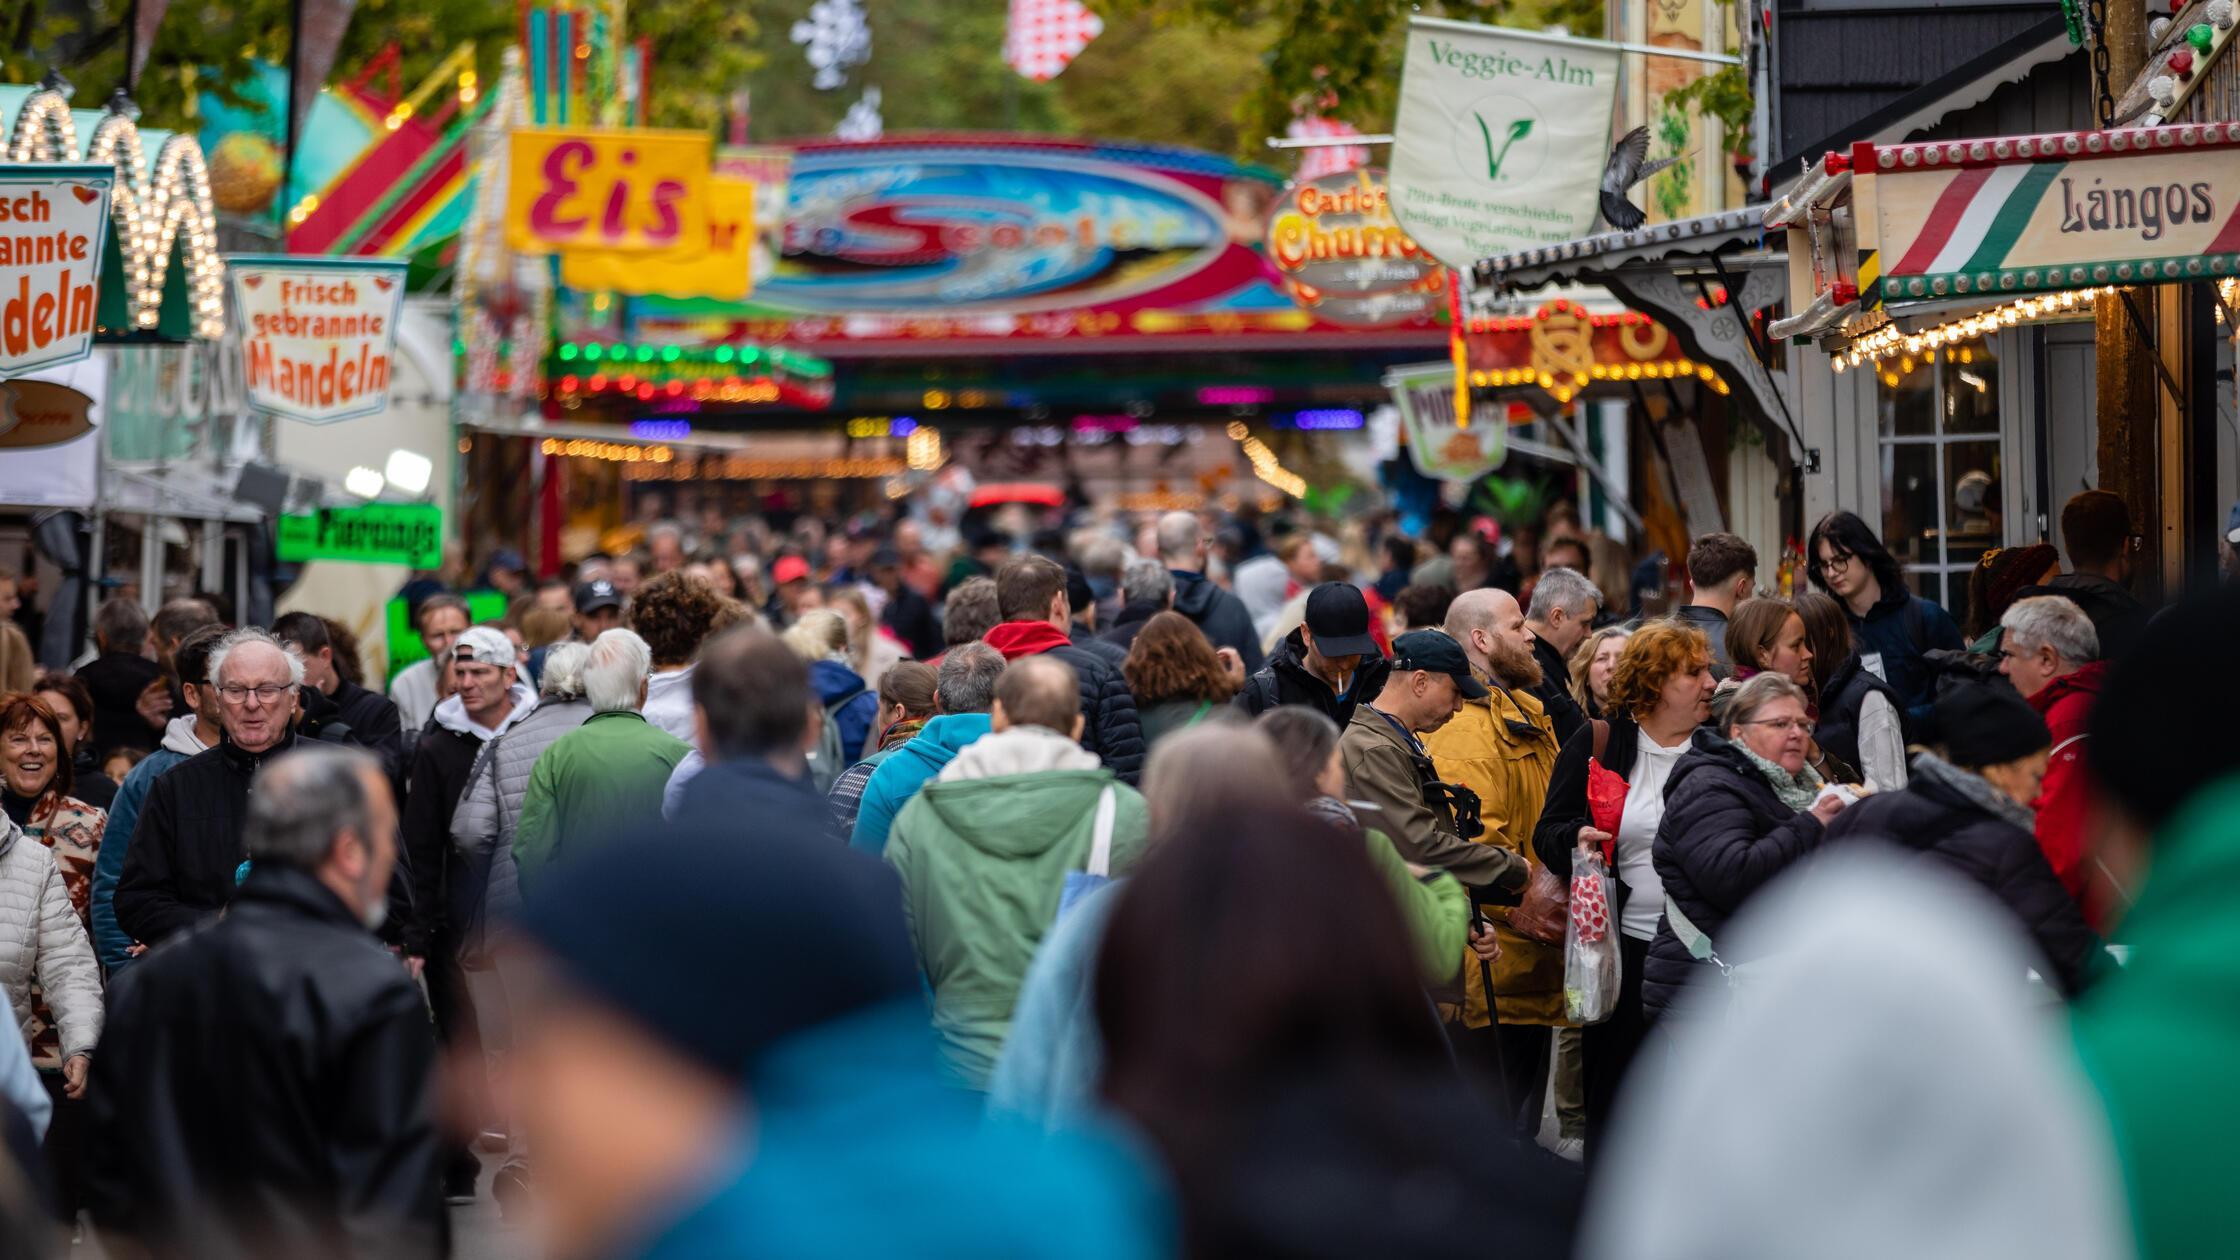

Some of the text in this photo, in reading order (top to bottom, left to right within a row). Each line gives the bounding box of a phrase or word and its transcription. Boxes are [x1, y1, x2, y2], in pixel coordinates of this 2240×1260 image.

[1428, 40, 1594, 87] Veggie-Alm
[529, 139, 687, 242] Eis
[1484, 201, 1574, 224] verschieden
[2060, 177, 2215, 240] Lángos
[0, 269, 94, 358] deln
[281, 274, 358, 304] Frisch
[253, 307, 383, 338] gebrannte
[246, 340, 390, 409] Mandeln
